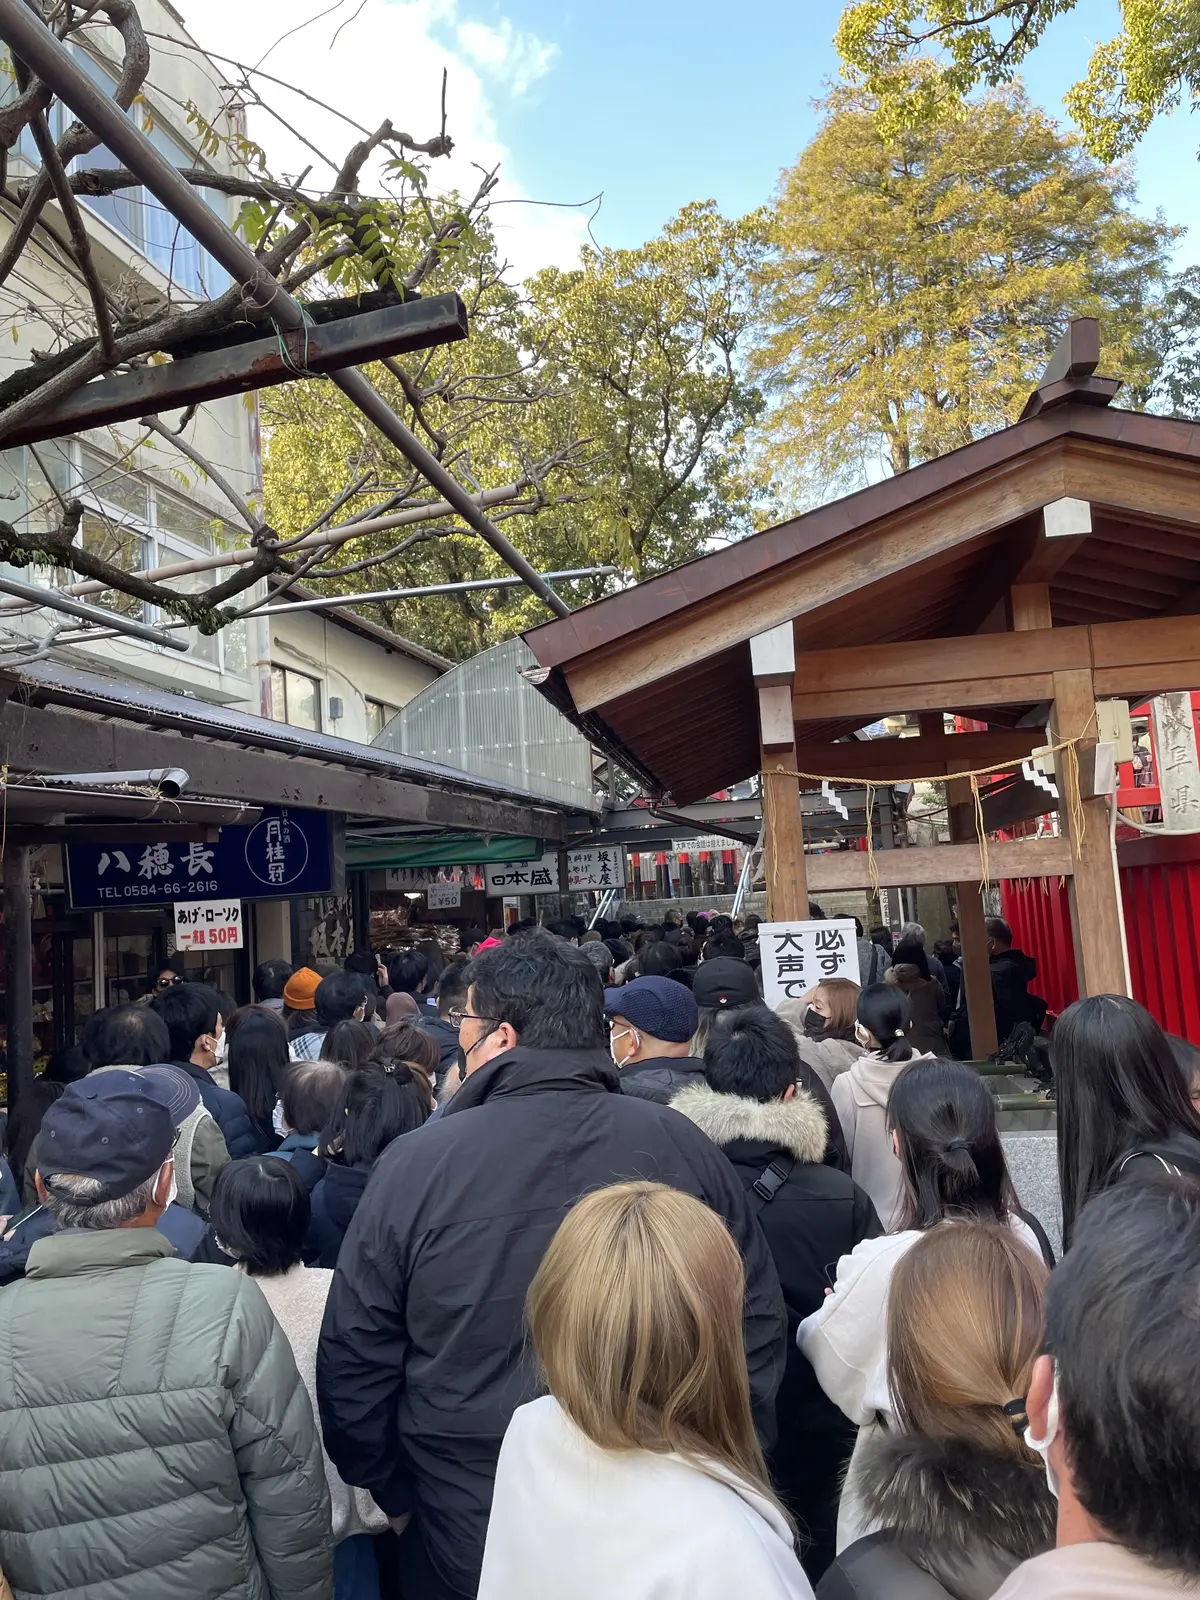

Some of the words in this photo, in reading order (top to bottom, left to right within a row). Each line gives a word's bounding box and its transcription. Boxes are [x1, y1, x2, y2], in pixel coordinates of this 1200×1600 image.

[265, 819, 285, 883] 月桂冠
[97, 842, 215, 880] 八穂長
[491, 868, 553, 886] 日本盛
[97, 887, 122, 899] TEL
[124, 881, 218, 897] 0584-66-2616
[438, 896, 457, 906] ¥50
[177, 906, 240, 924] あげ・ローソク
[180, 928, 206, 945] 一組
[208, 927, 238, 944] 50円
[773, 929, 807, 999] 大声で
[814, 929, 847, 982] 必ず
